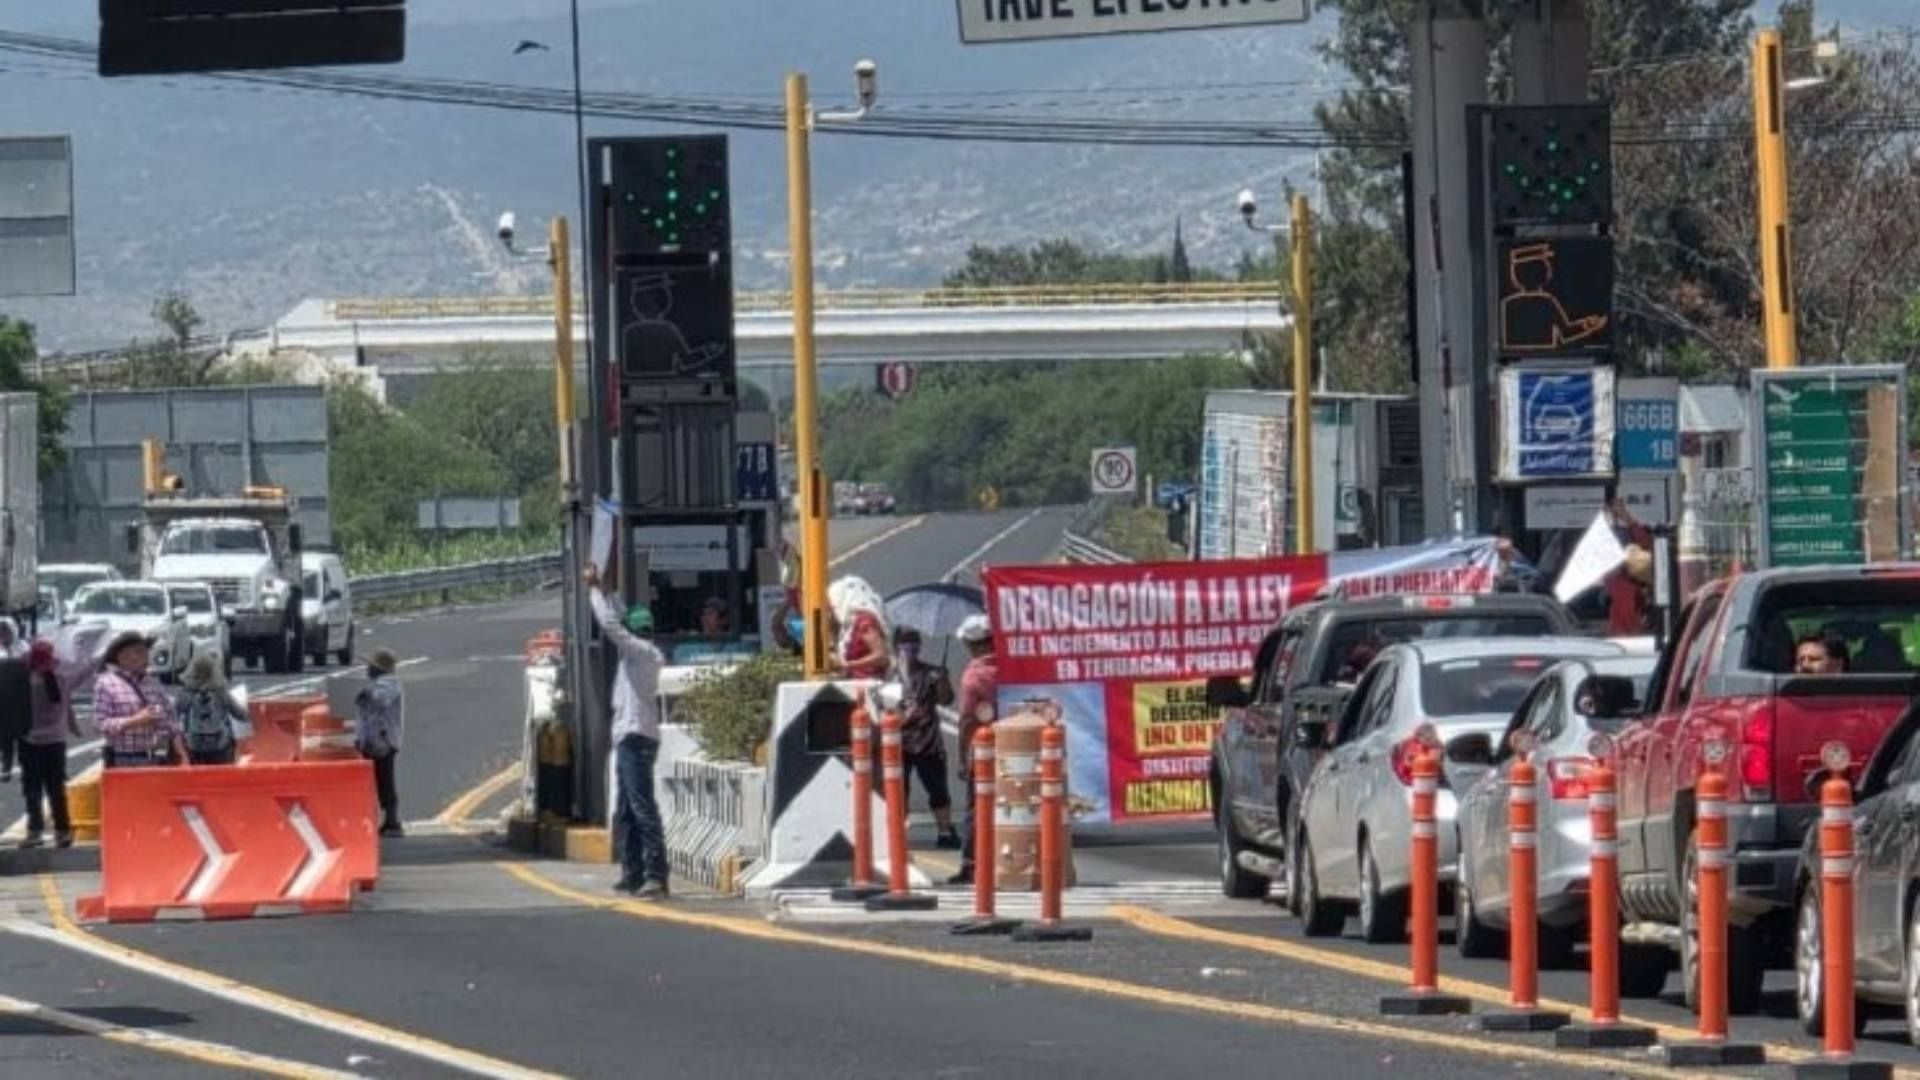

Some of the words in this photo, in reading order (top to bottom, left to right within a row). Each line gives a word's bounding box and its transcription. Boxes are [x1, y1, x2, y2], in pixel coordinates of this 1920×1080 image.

[997, 572, 1176, 631] DEROGACIÓN
[1184, 578, 1202, 625] A
[1208, 576, 1241, 622] LA
[1246, 574, 1292, 620] LEY
[1040, 629, 1154, 656] INCREMENTO
[1159, 628, 1180, 649] AL
[1184, 625, 1233, 648] AGUA
[1237, 624, 1271, 645] POT
[1057, 658, 1079, 680] EN
[1165, 687, 1181, 703] EL
